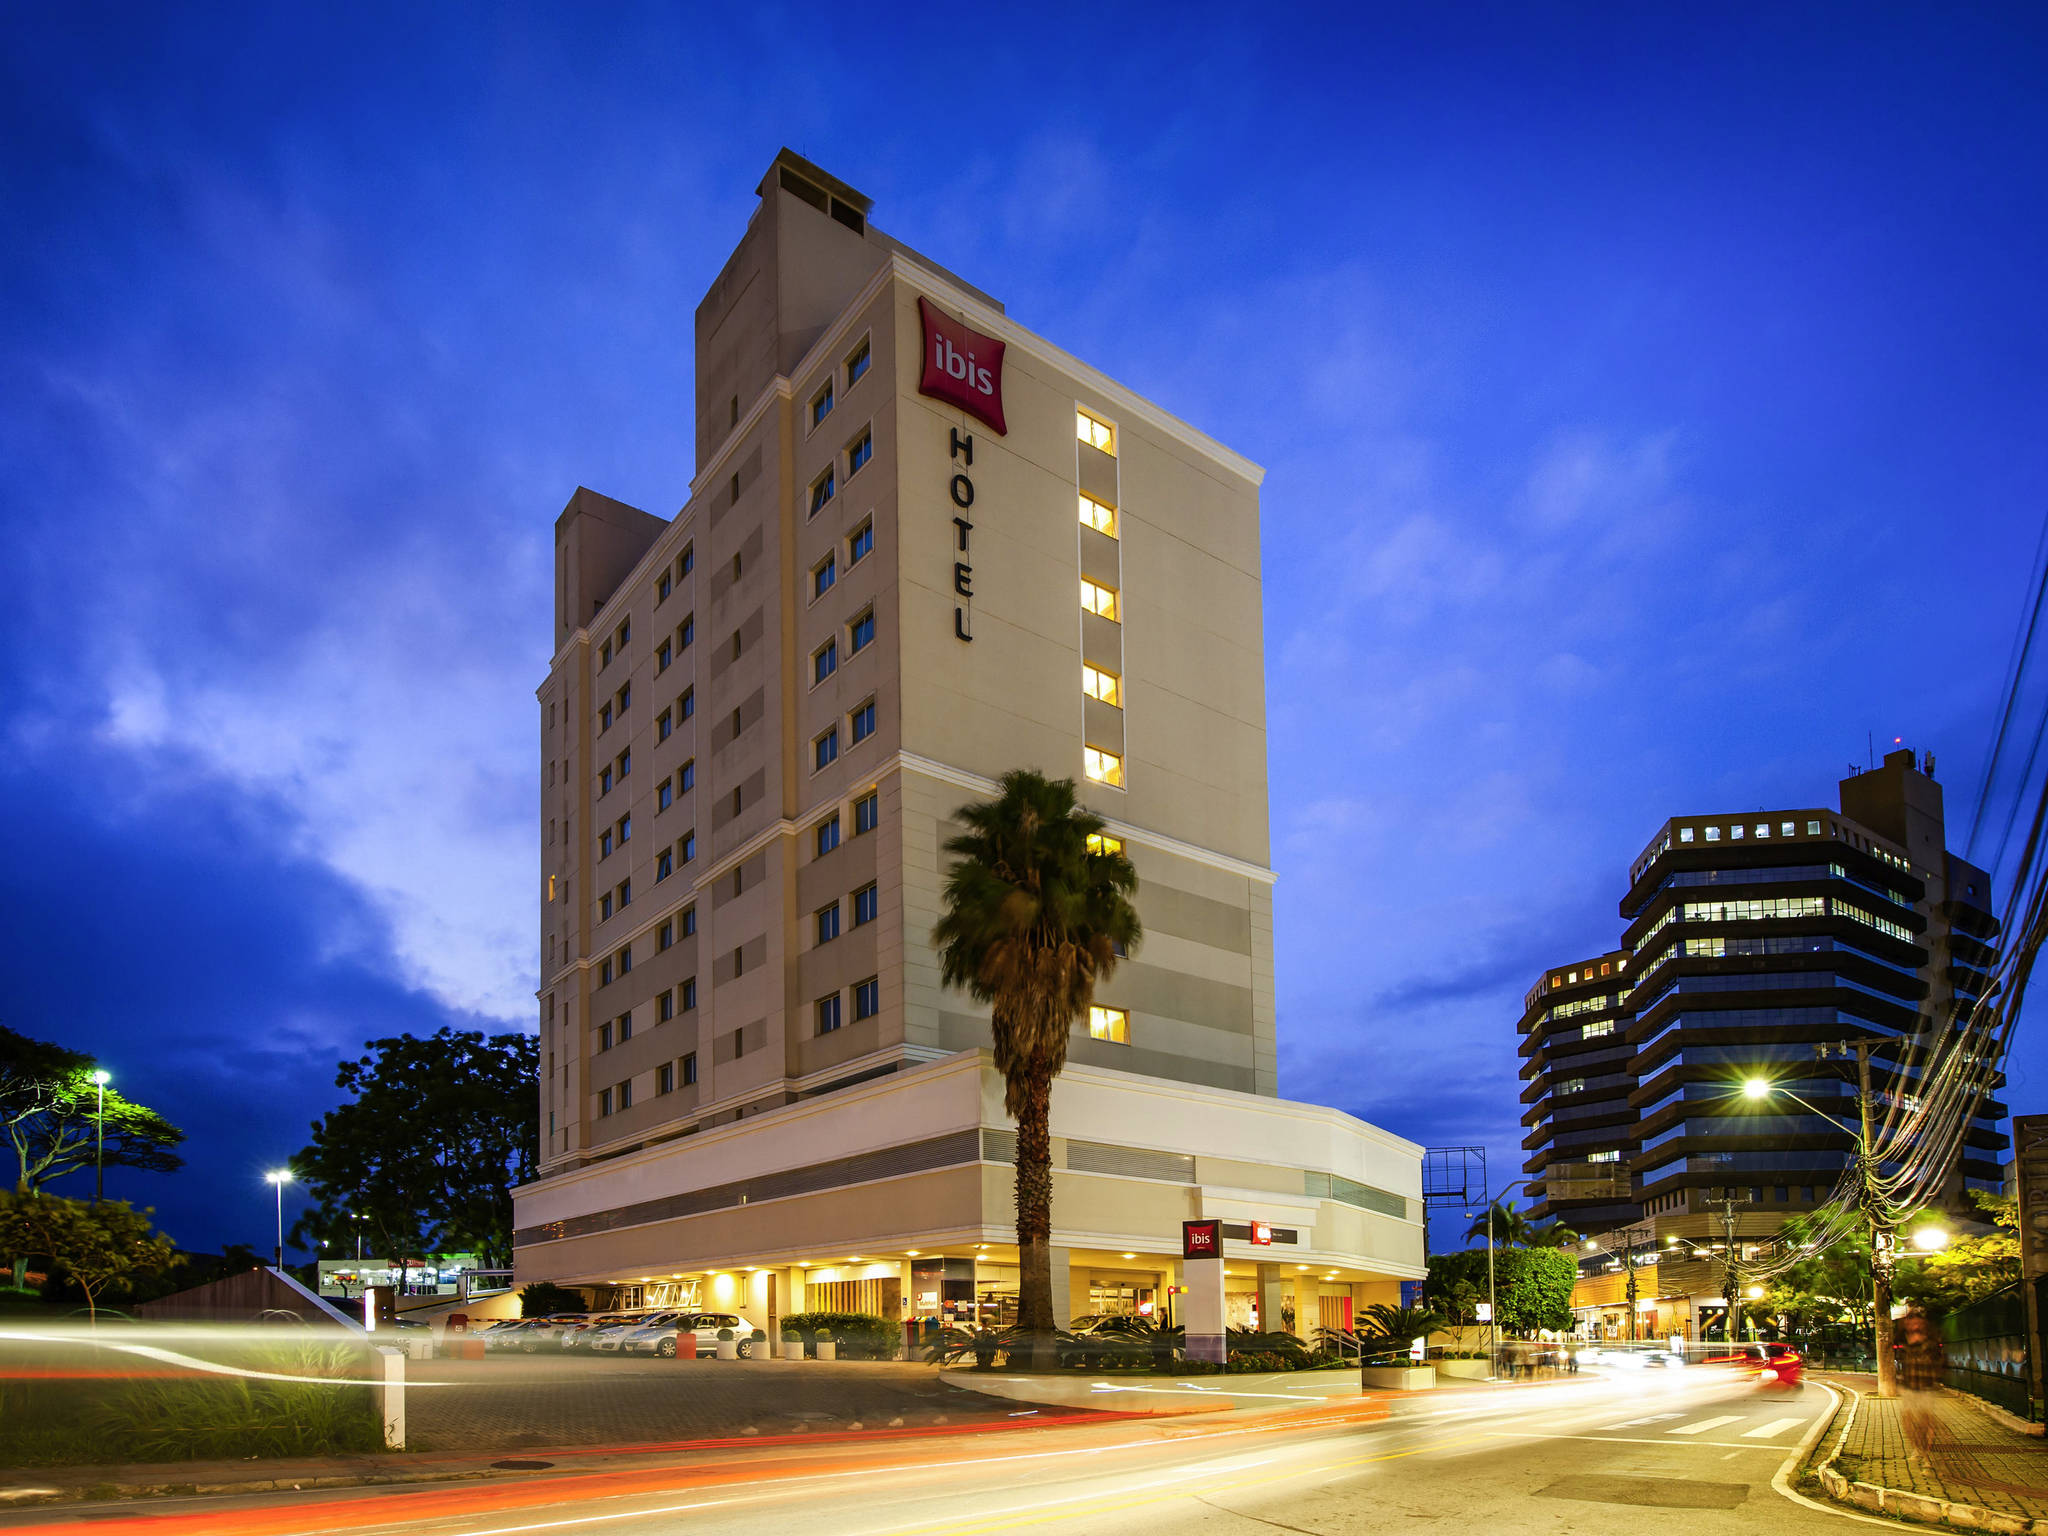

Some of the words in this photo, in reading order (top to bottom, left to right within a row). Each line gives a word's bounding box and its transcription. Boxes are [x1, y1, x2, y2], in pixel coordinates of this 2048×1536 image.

[935, 333, 994, 396] ibis
[950, 426, 974, 642] HOTEL
[1191, 1232, 1211, 1245] ibis
